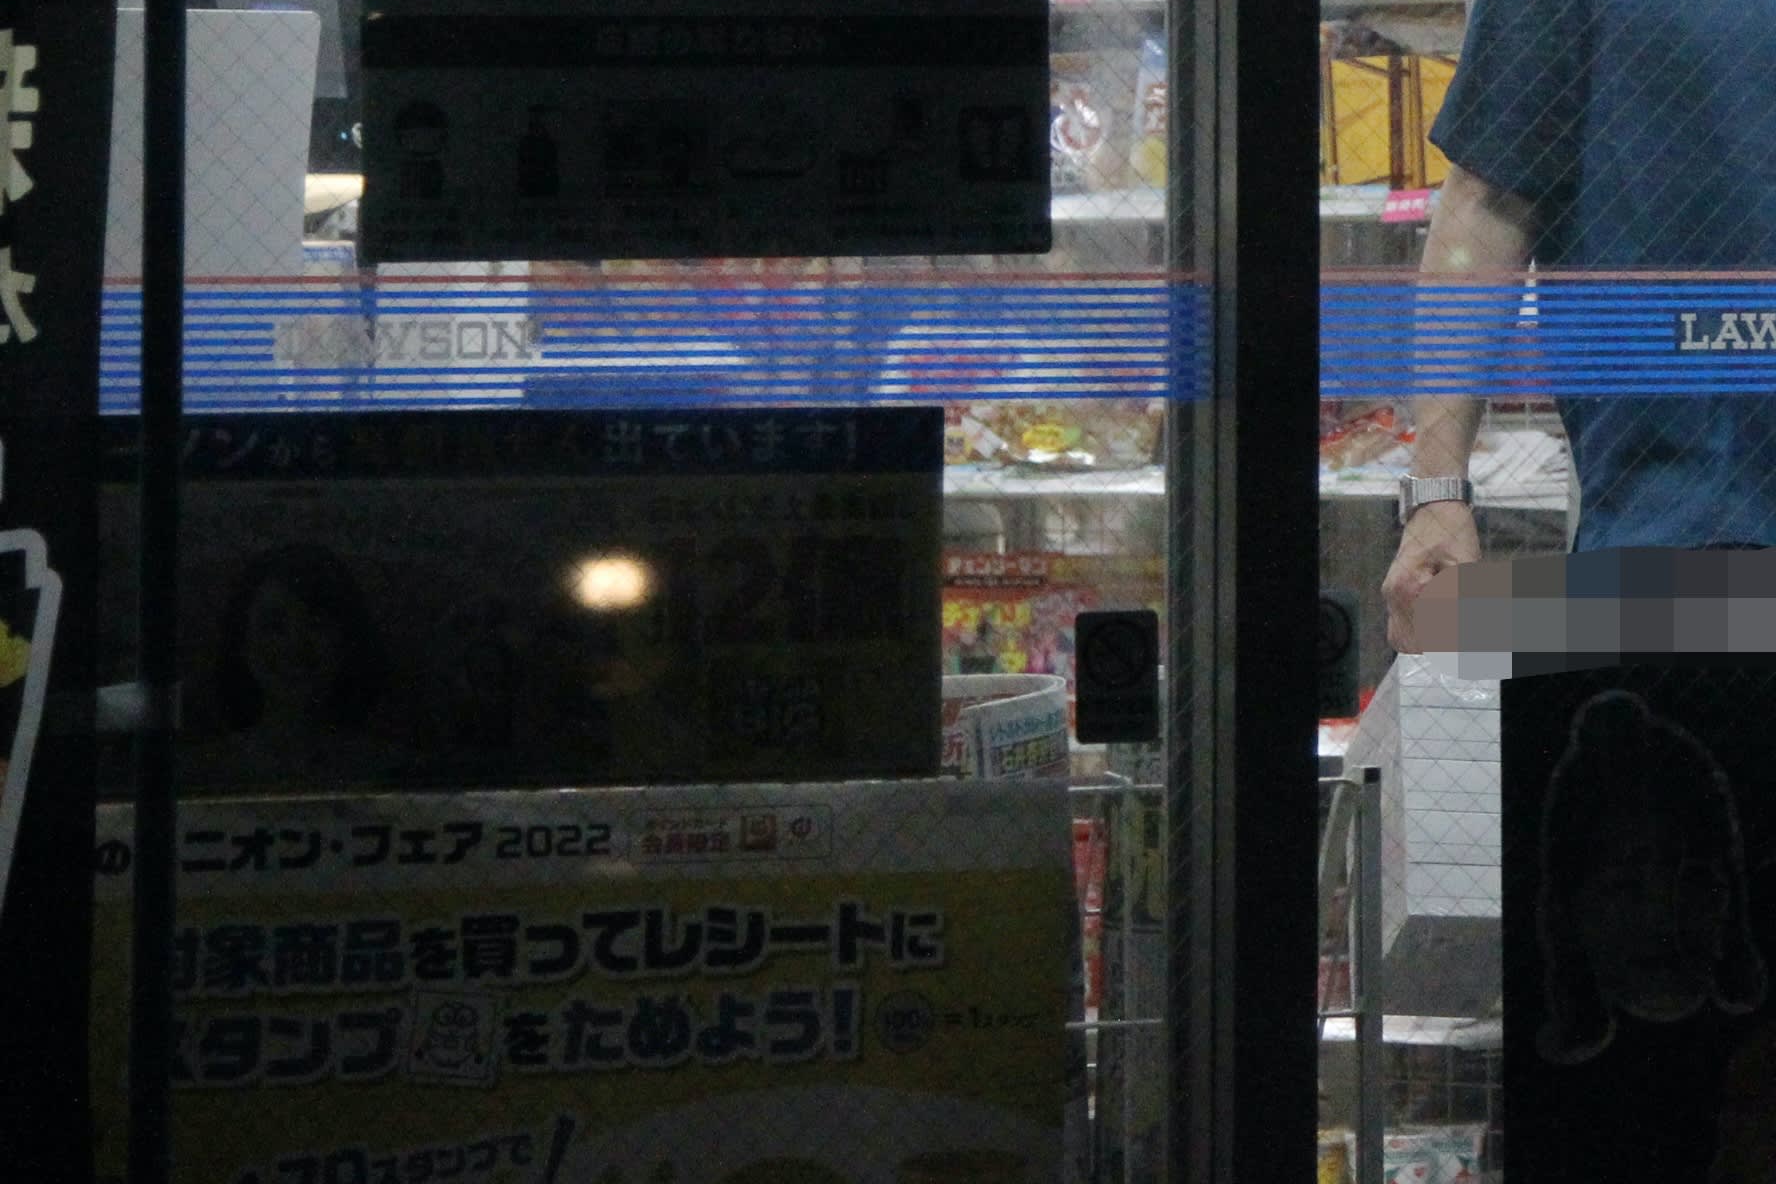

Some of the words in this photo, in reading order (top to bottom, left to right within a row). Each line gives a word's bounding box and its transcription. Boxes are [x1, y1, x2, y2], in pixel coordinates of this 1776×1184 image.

[182, 820, 483, 874] ニオン・フェア
[496, 822, 612, 858] 2022
[502, 993, 858, 1068] をためよう!
